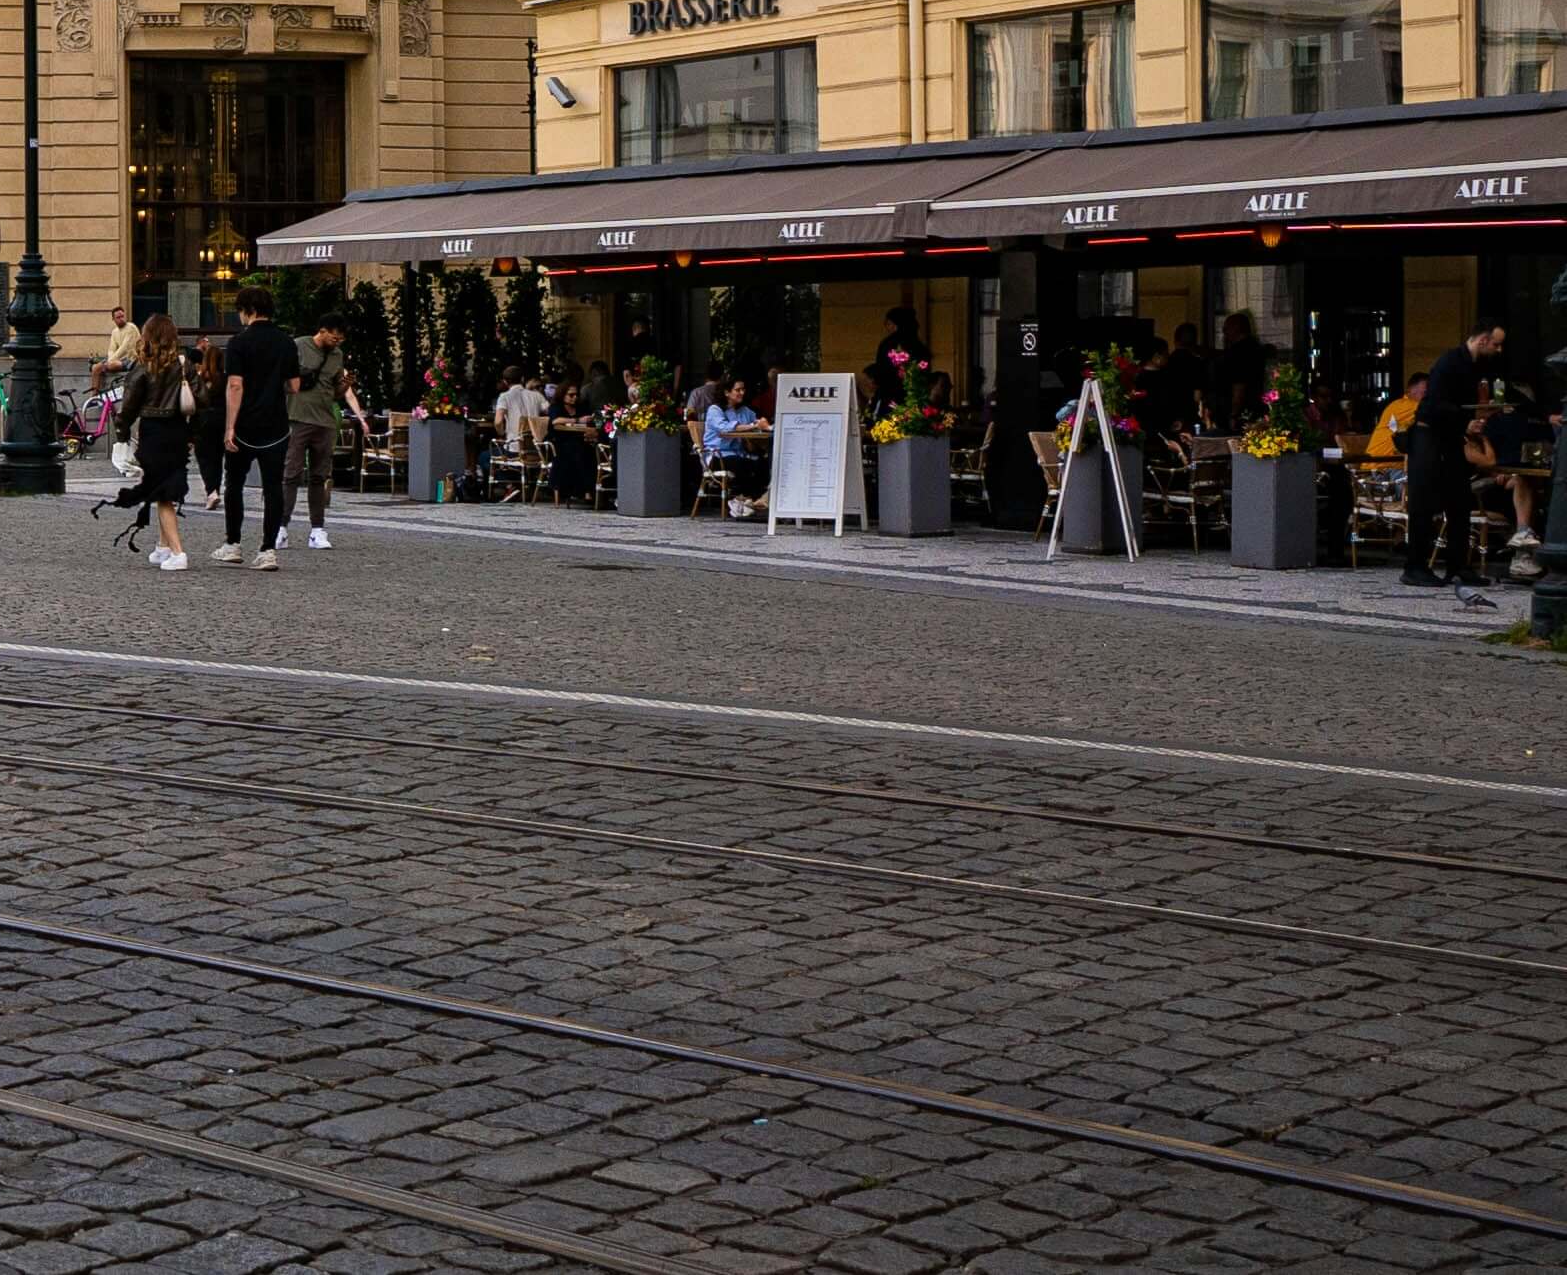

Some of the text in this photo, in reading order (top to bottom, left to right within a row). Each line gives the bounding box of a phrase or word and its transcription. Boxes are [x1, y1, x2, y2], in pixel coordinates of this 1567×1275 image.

[1454, 176, 1529, 198] ADELE
[1244, 192, 1310, 212] ADELE
[1062, 204, 1120, 224] ADELE
[597, 231, 637, 246] ADELE
[778, 222, 825, 238] ADELE
[788, 386, 839, 399] ADELE
